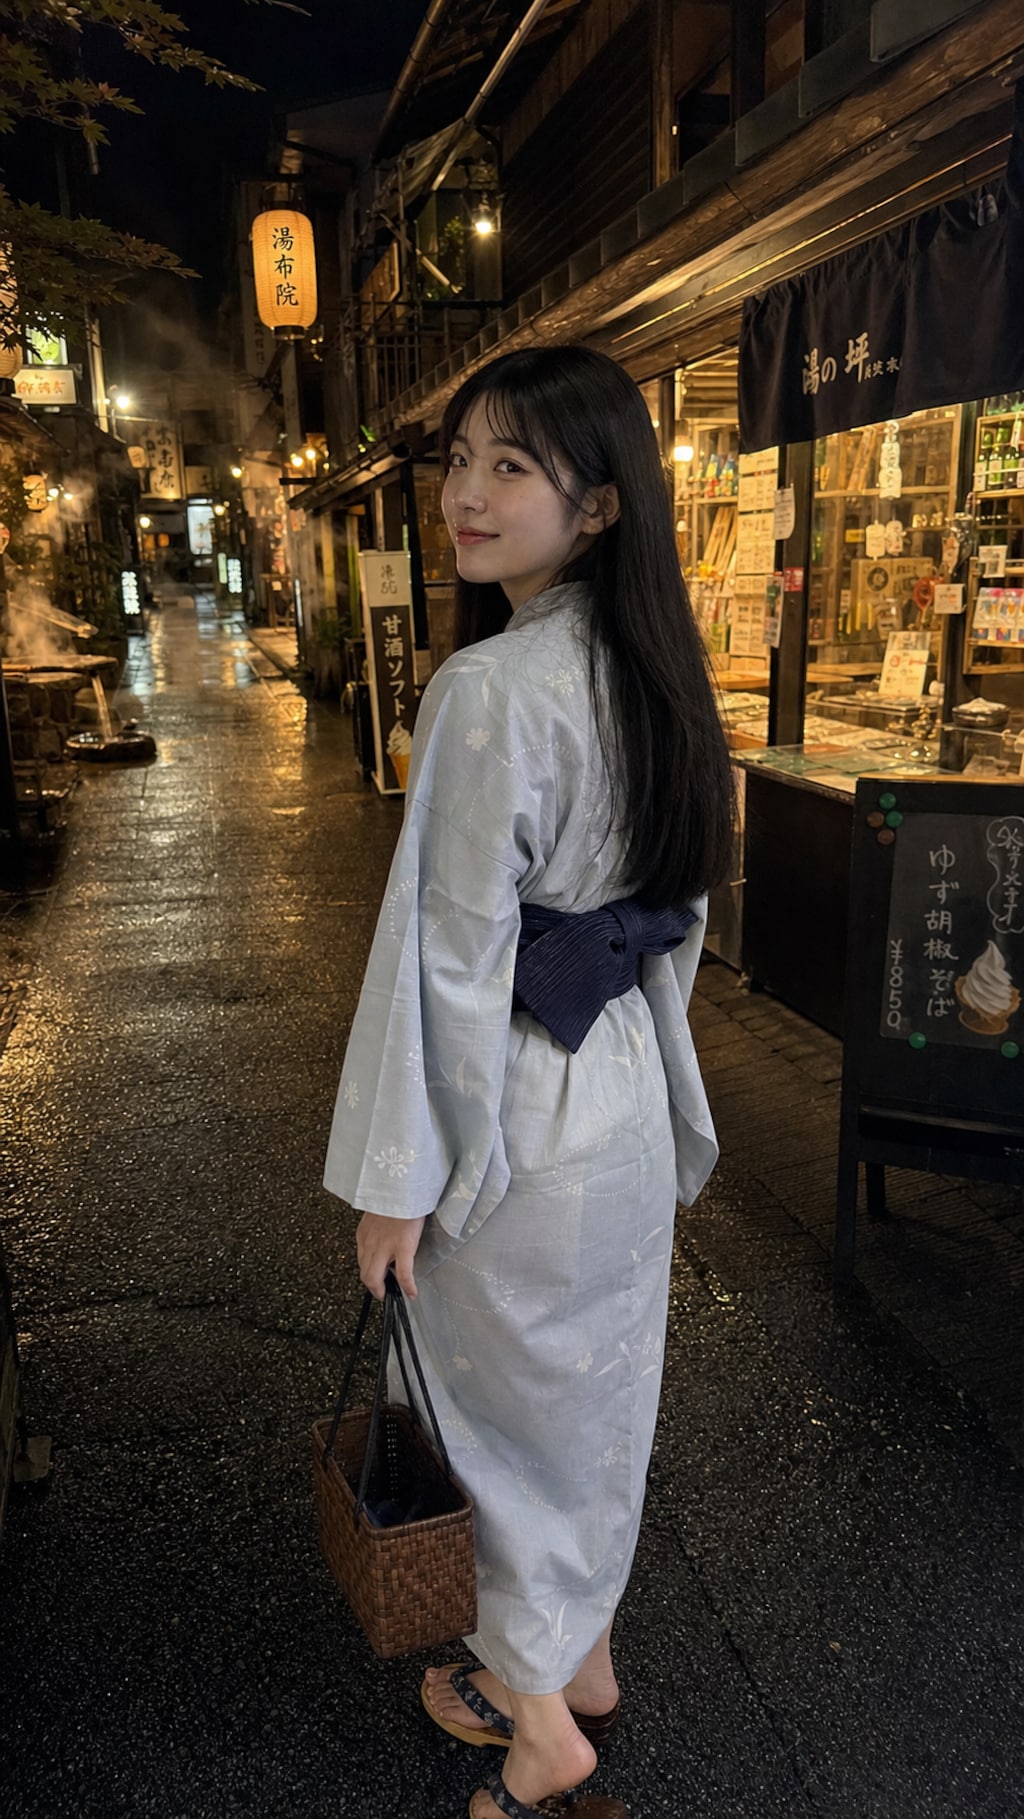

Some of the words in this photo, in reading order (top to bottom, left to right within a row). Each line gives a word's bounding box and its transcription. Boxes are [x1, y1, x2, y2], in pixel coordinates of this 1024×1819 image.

[272, 226, 299, 306] 湯布院
[802, 331, 870, 395] 湯の坪
[381, 613, 407, 717] 甘酒ソフト
[923, 844, 959, 1017] ゆず胡椒そば
